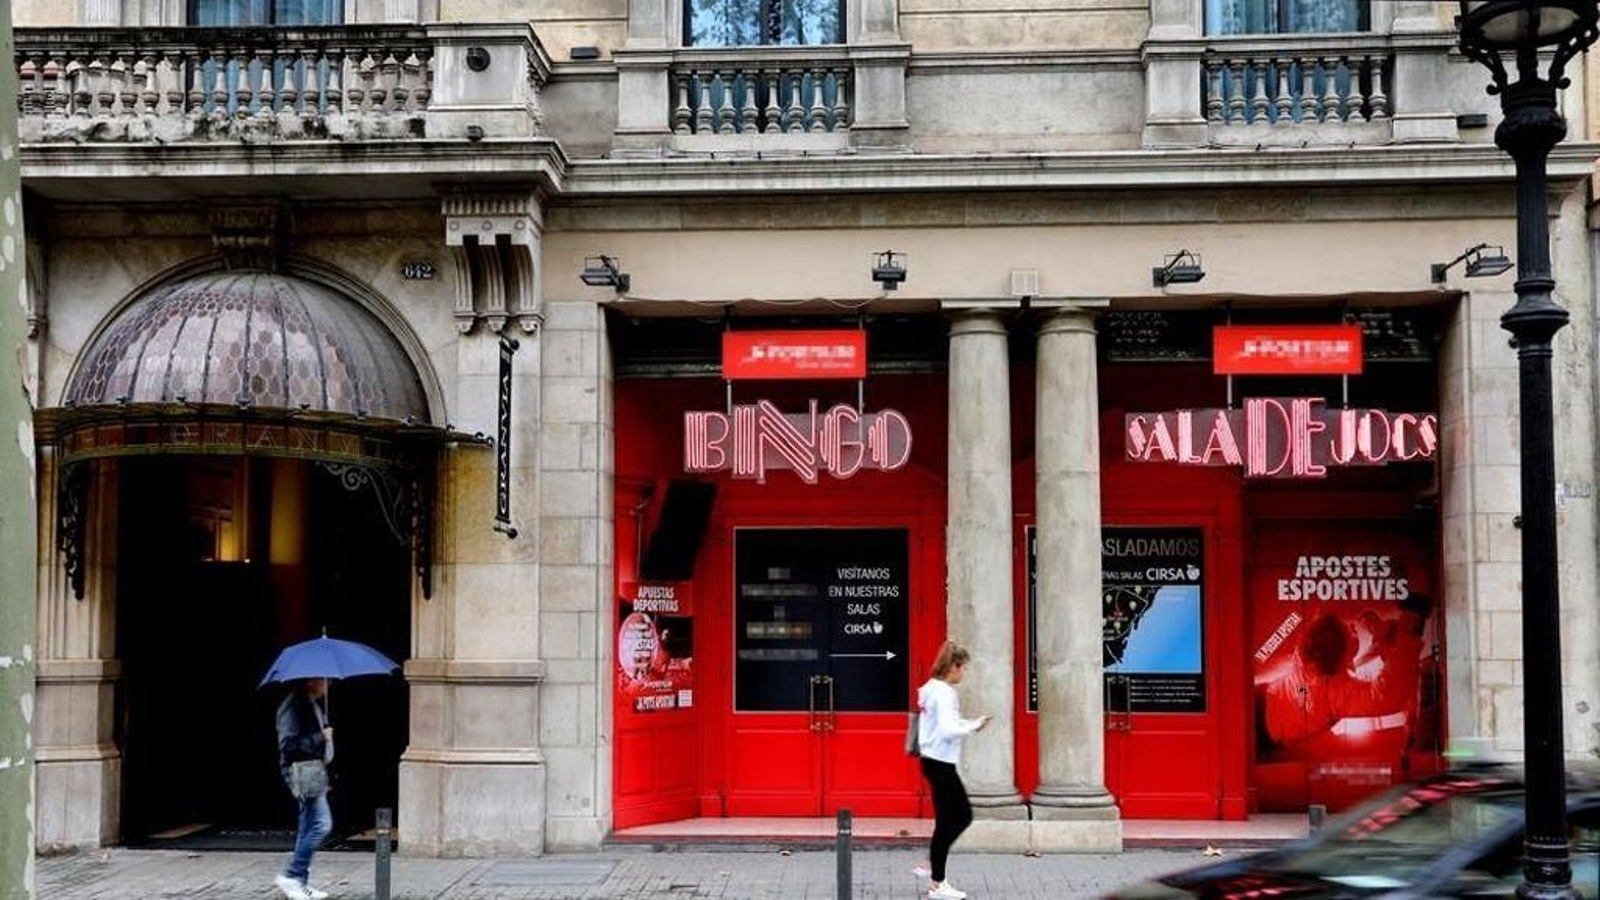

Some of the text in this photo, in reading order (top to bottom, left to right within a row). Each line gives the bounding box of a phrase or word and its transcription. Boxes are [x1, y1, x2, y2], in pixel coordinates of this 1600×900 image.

[404, 264, 432, 278] 642
[684, 399, 912, 484] BINGO
[1128, 397, 1437, 477] SALA DE JOCS
[1101, 537, 1200, 557] SLADAMOS
[837, 565, 890, 580] VISÍTANOS
[1146, 566, 1185, 581] CIRSA
[1296, 556, 1391, 578] APOSTES
[829, 585, 842, 598] EN
[844, 585, 899, 598] NUESTRAS
[1277, 578, 1409, 601] ESPORTIVES
[847, 602, 881, 616] SALAS
[844, 623, 873, 635] CIRSA
